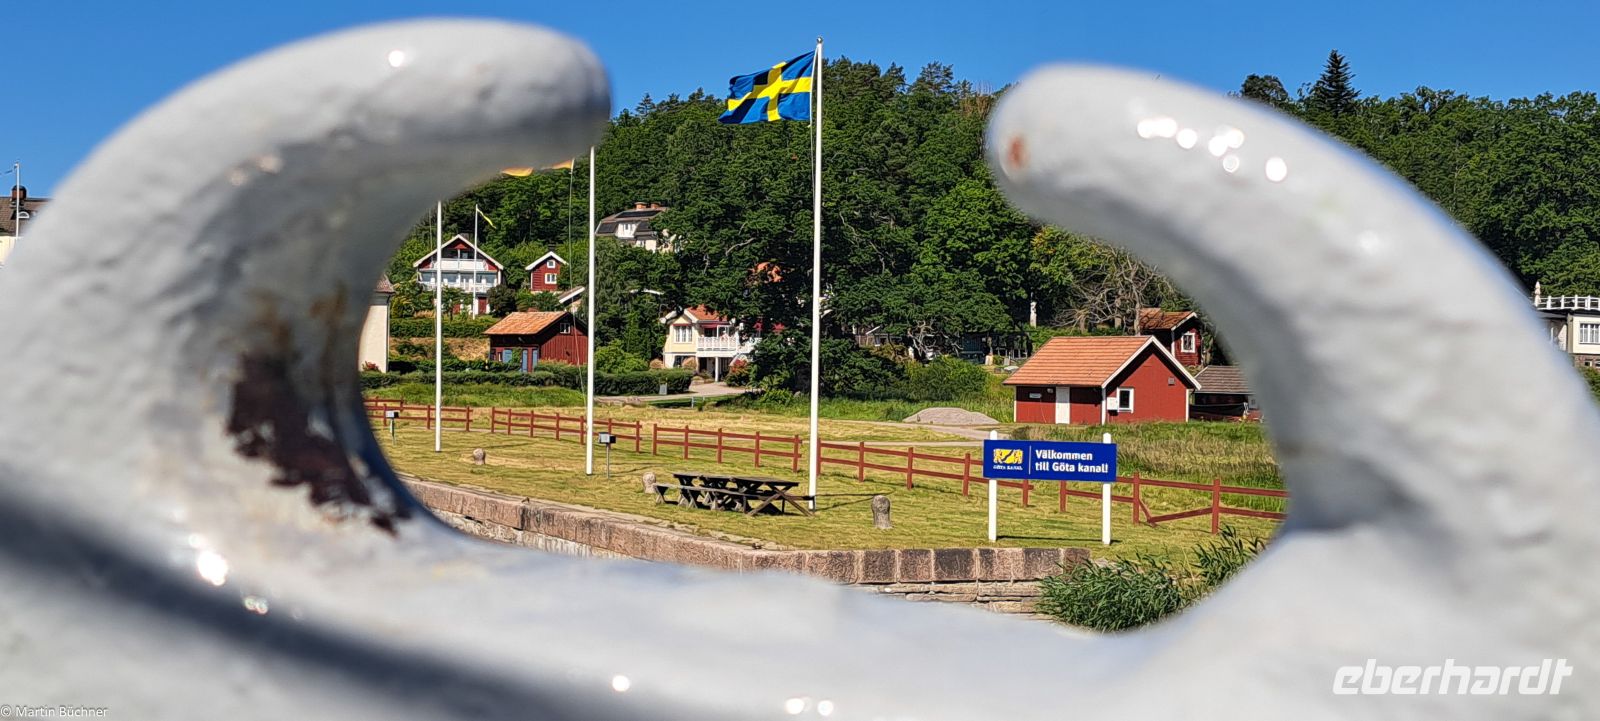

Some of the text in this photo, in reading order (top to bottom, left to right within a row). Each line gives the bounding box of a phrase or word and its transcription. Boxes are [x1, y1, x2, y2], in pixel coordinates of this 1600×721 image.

[1035, 449, 1093, 461] Välkommen
[1035, 461, 1108, 473] till Göta kanal!
